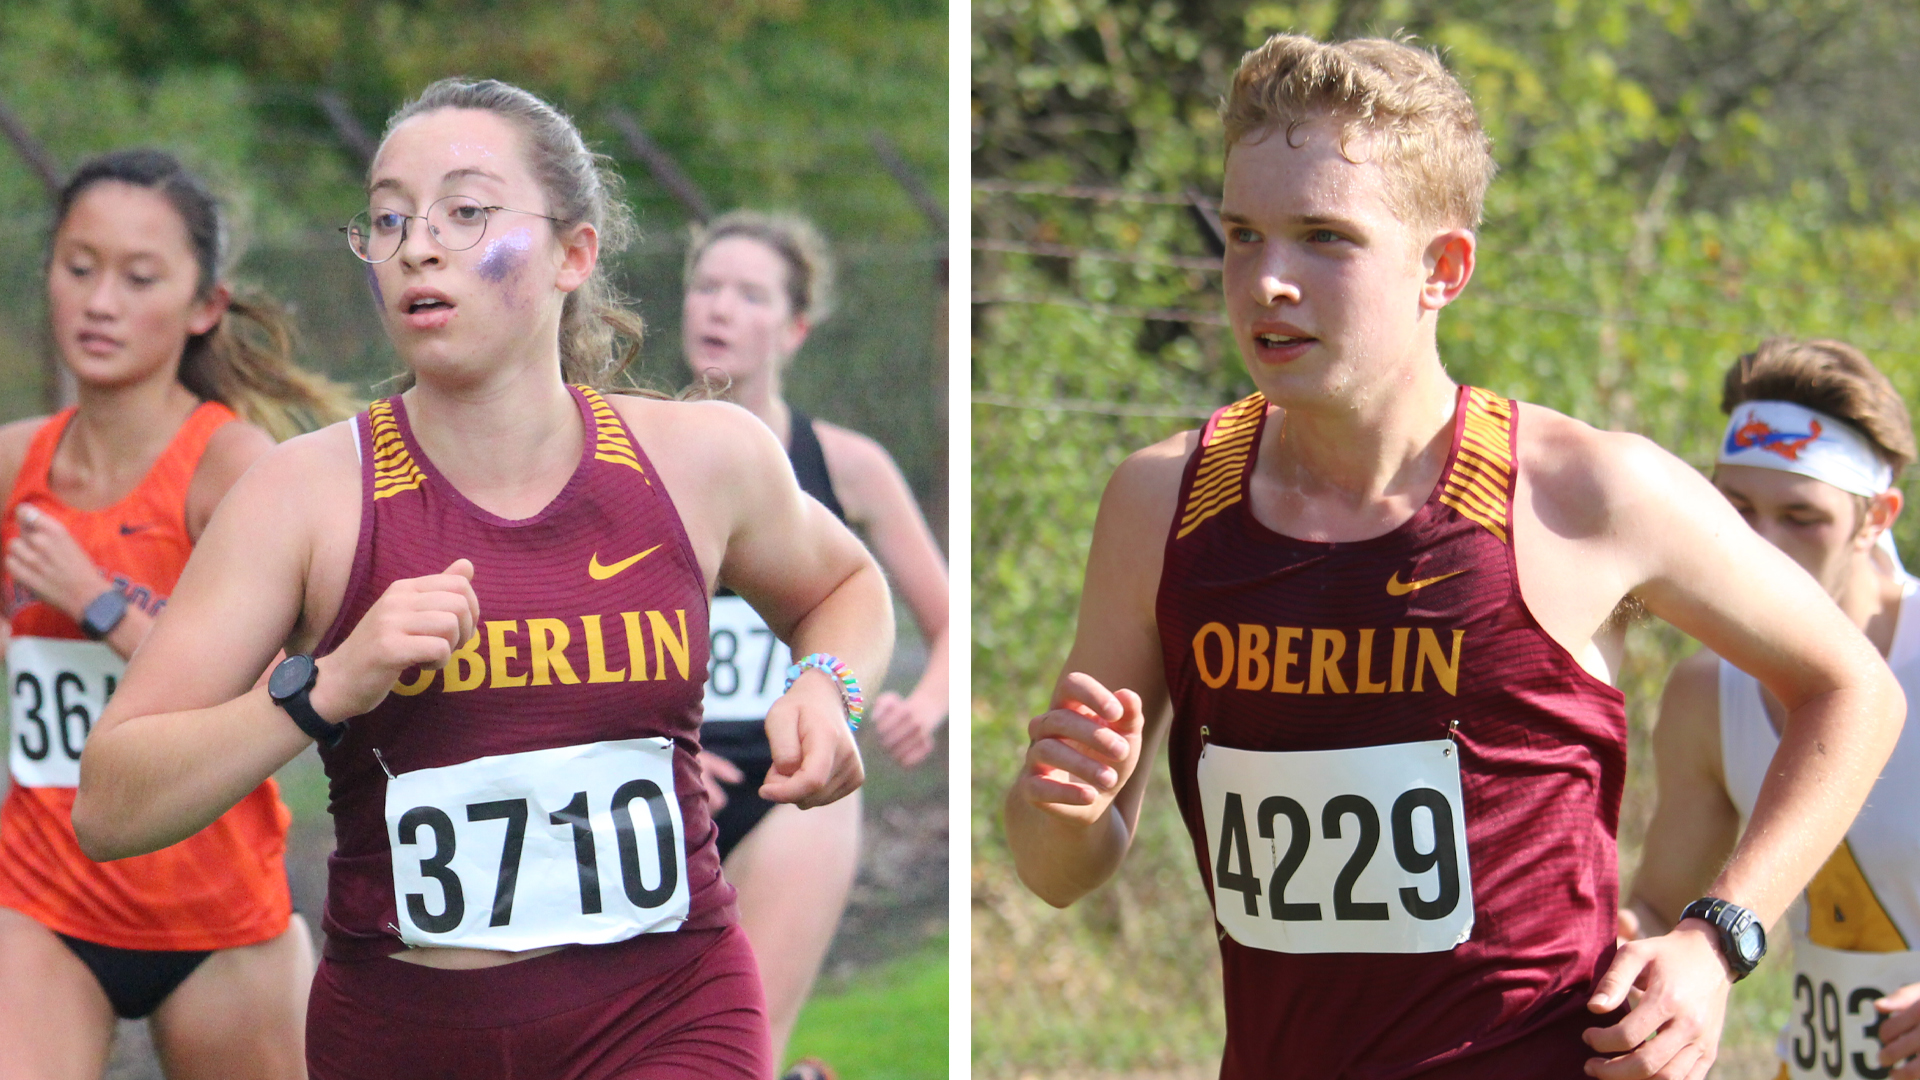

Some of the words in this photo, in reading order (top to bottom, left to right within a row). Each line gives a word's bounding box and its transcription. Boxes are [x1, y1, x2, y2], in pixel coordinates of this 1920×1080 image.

[711, 629, 776, 697] 87
[1192, 622, 1465, 697] OBERLIN
[15, 671, 118, 761] 36
[398, 779, 678, 934] 3710
[1216, 787, 1460, 921] 4229
